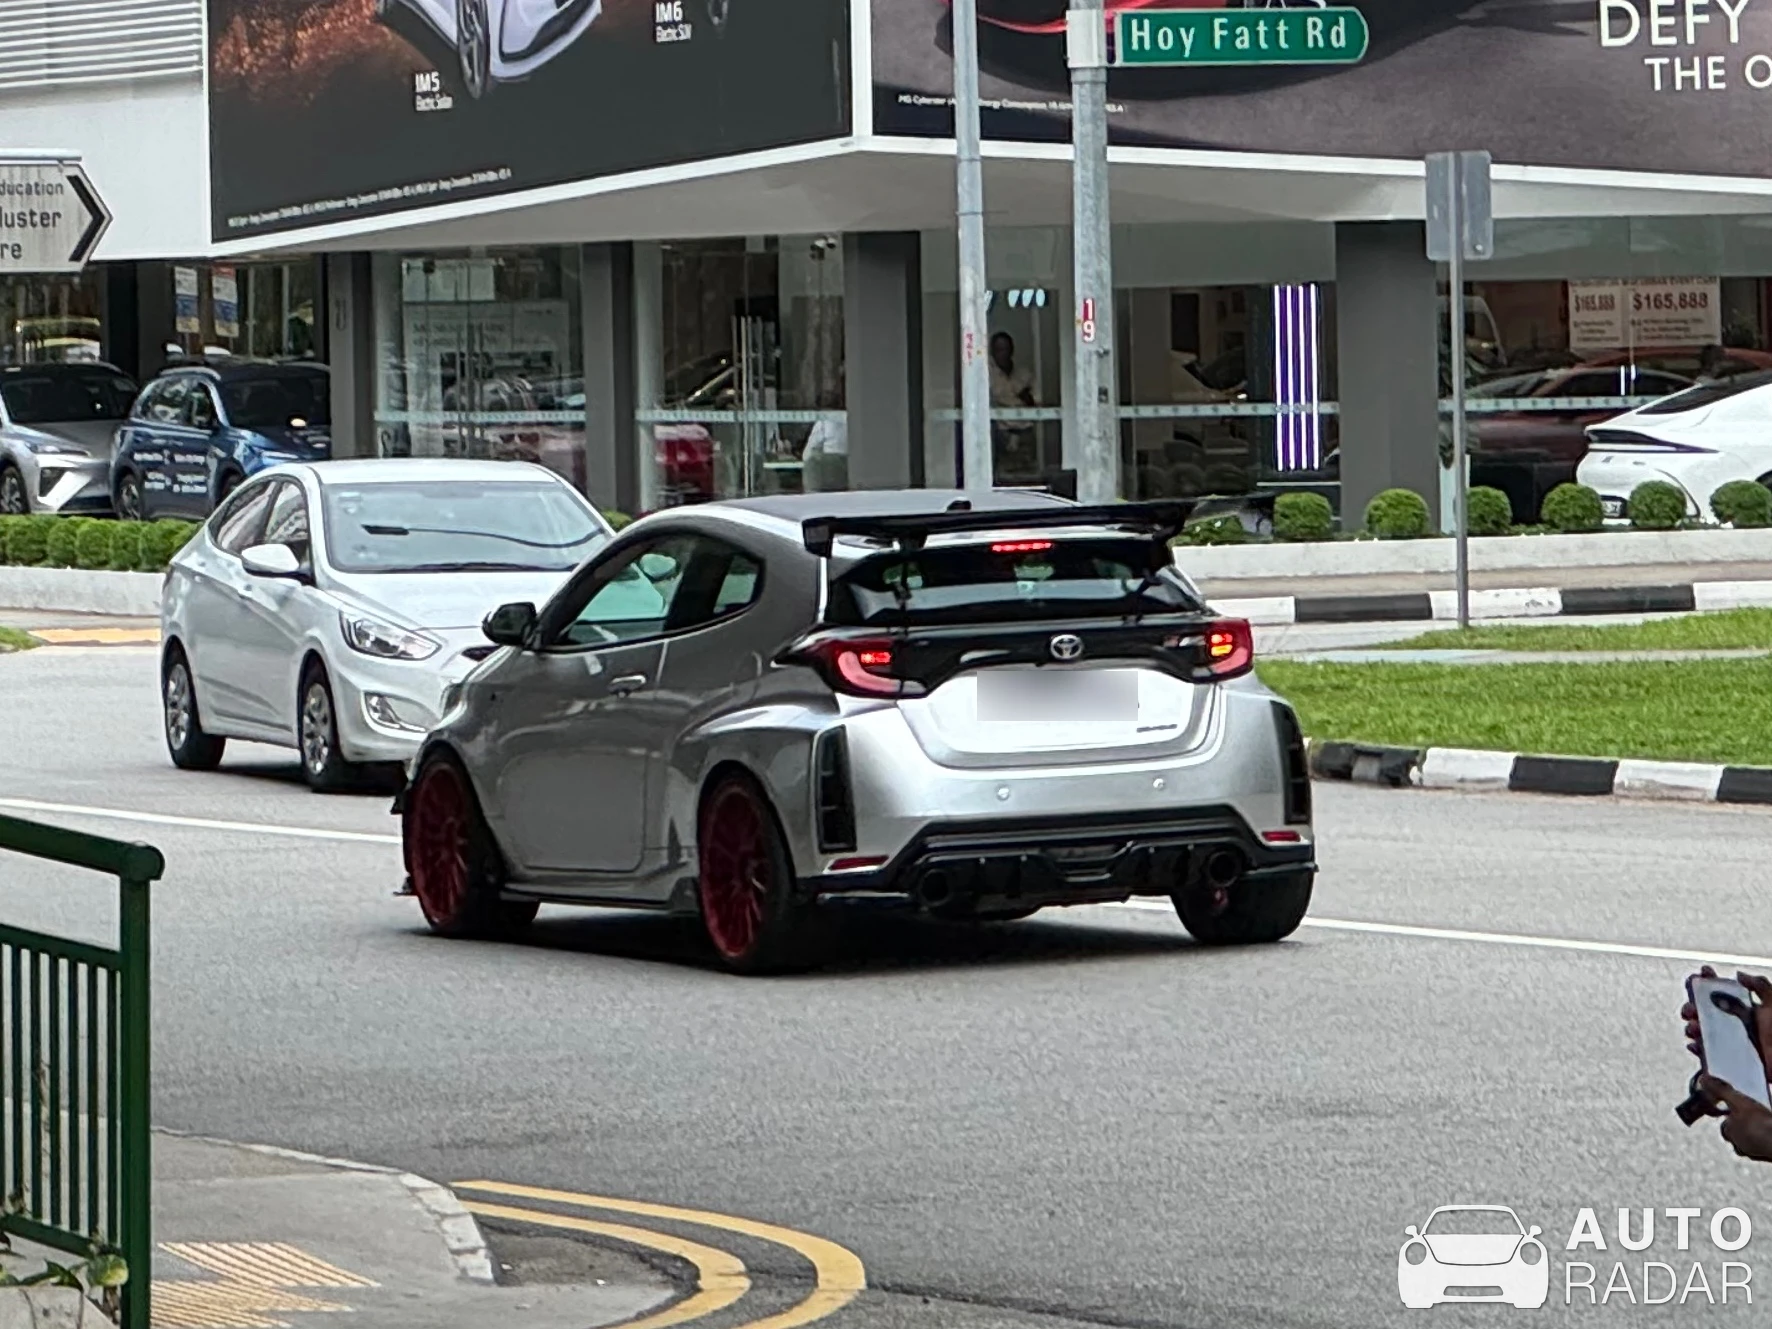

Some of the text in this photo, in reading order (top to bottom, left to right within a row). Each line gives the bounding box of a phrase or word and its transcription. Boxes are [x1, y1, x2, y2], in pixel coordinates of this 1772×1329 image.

[656, 1, 683, 23] IM6
[1600, 0, 1749, 47] DEFY
[1131, 16, 1346, 58] Hoy Fatt Rd
[1644, 56, 1726, 91] THE
